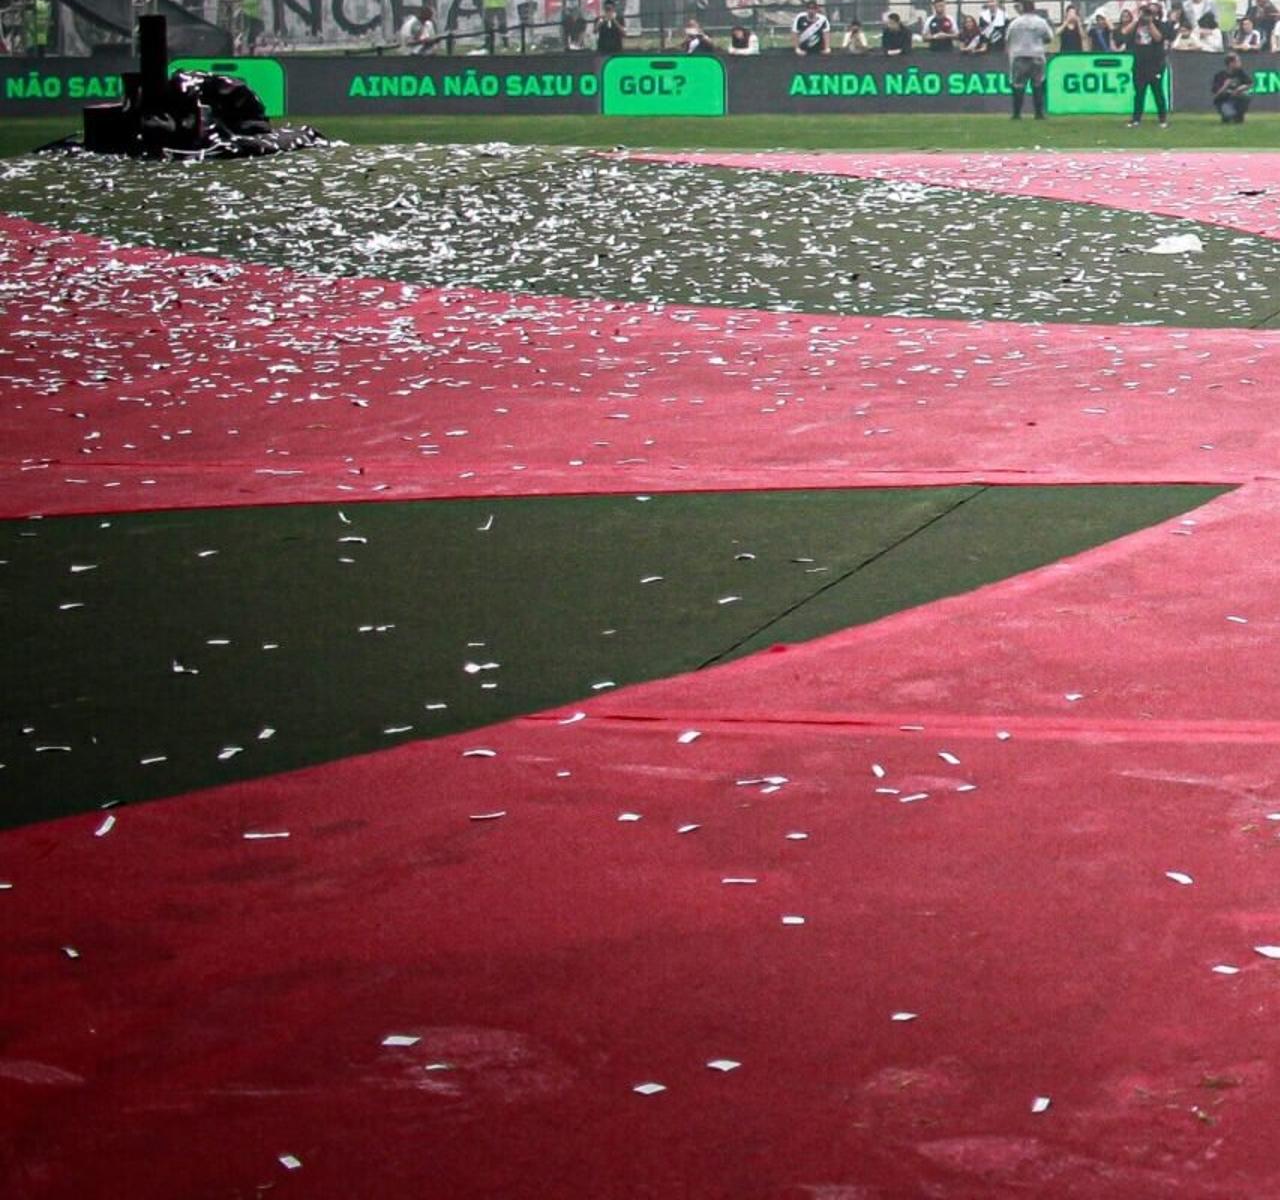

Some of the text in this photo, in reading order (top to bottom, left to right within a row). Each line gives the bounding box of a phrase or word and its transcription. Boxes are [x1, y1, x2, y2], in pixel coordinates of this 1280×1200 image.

[6, 72, 123, 98] NÃO SAI
[350, 70, 597, 96] AINDA NÃO SAIU O
[619, 75, 686, 95] GOL?
[790, 74, 877, 94] AINDA
[885, 68, 940, 94] NÃO
[1062, 72, 1131, 93] GOL?
